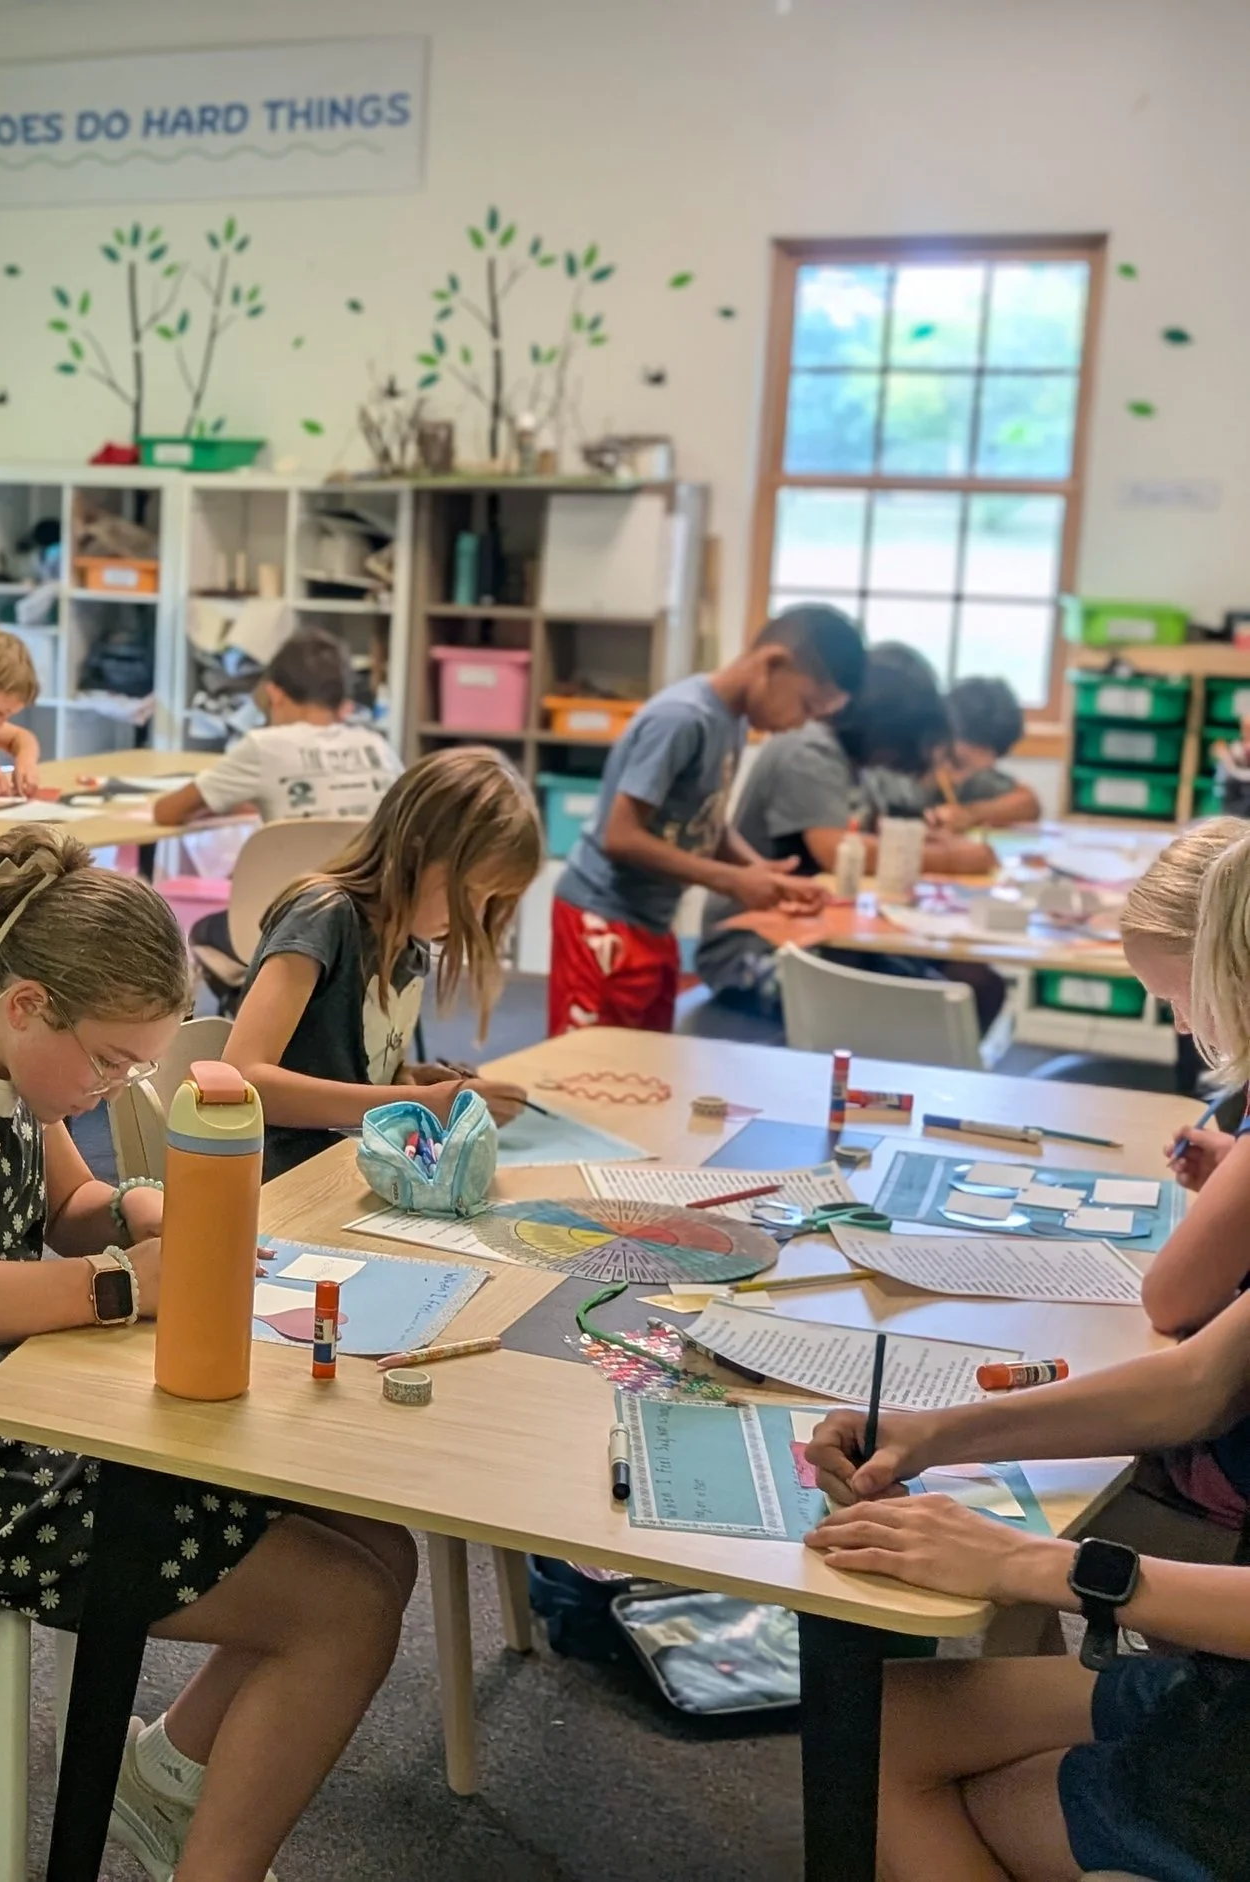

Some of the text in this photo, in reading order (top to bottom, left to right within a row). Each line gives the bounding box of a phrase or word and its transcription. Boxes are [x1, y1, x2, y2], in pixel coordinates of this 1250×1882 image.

[75, 109, 131, 142] DO
[142, 103, 250, 139] HARD
[262, 92, 411, 132] THINGS
